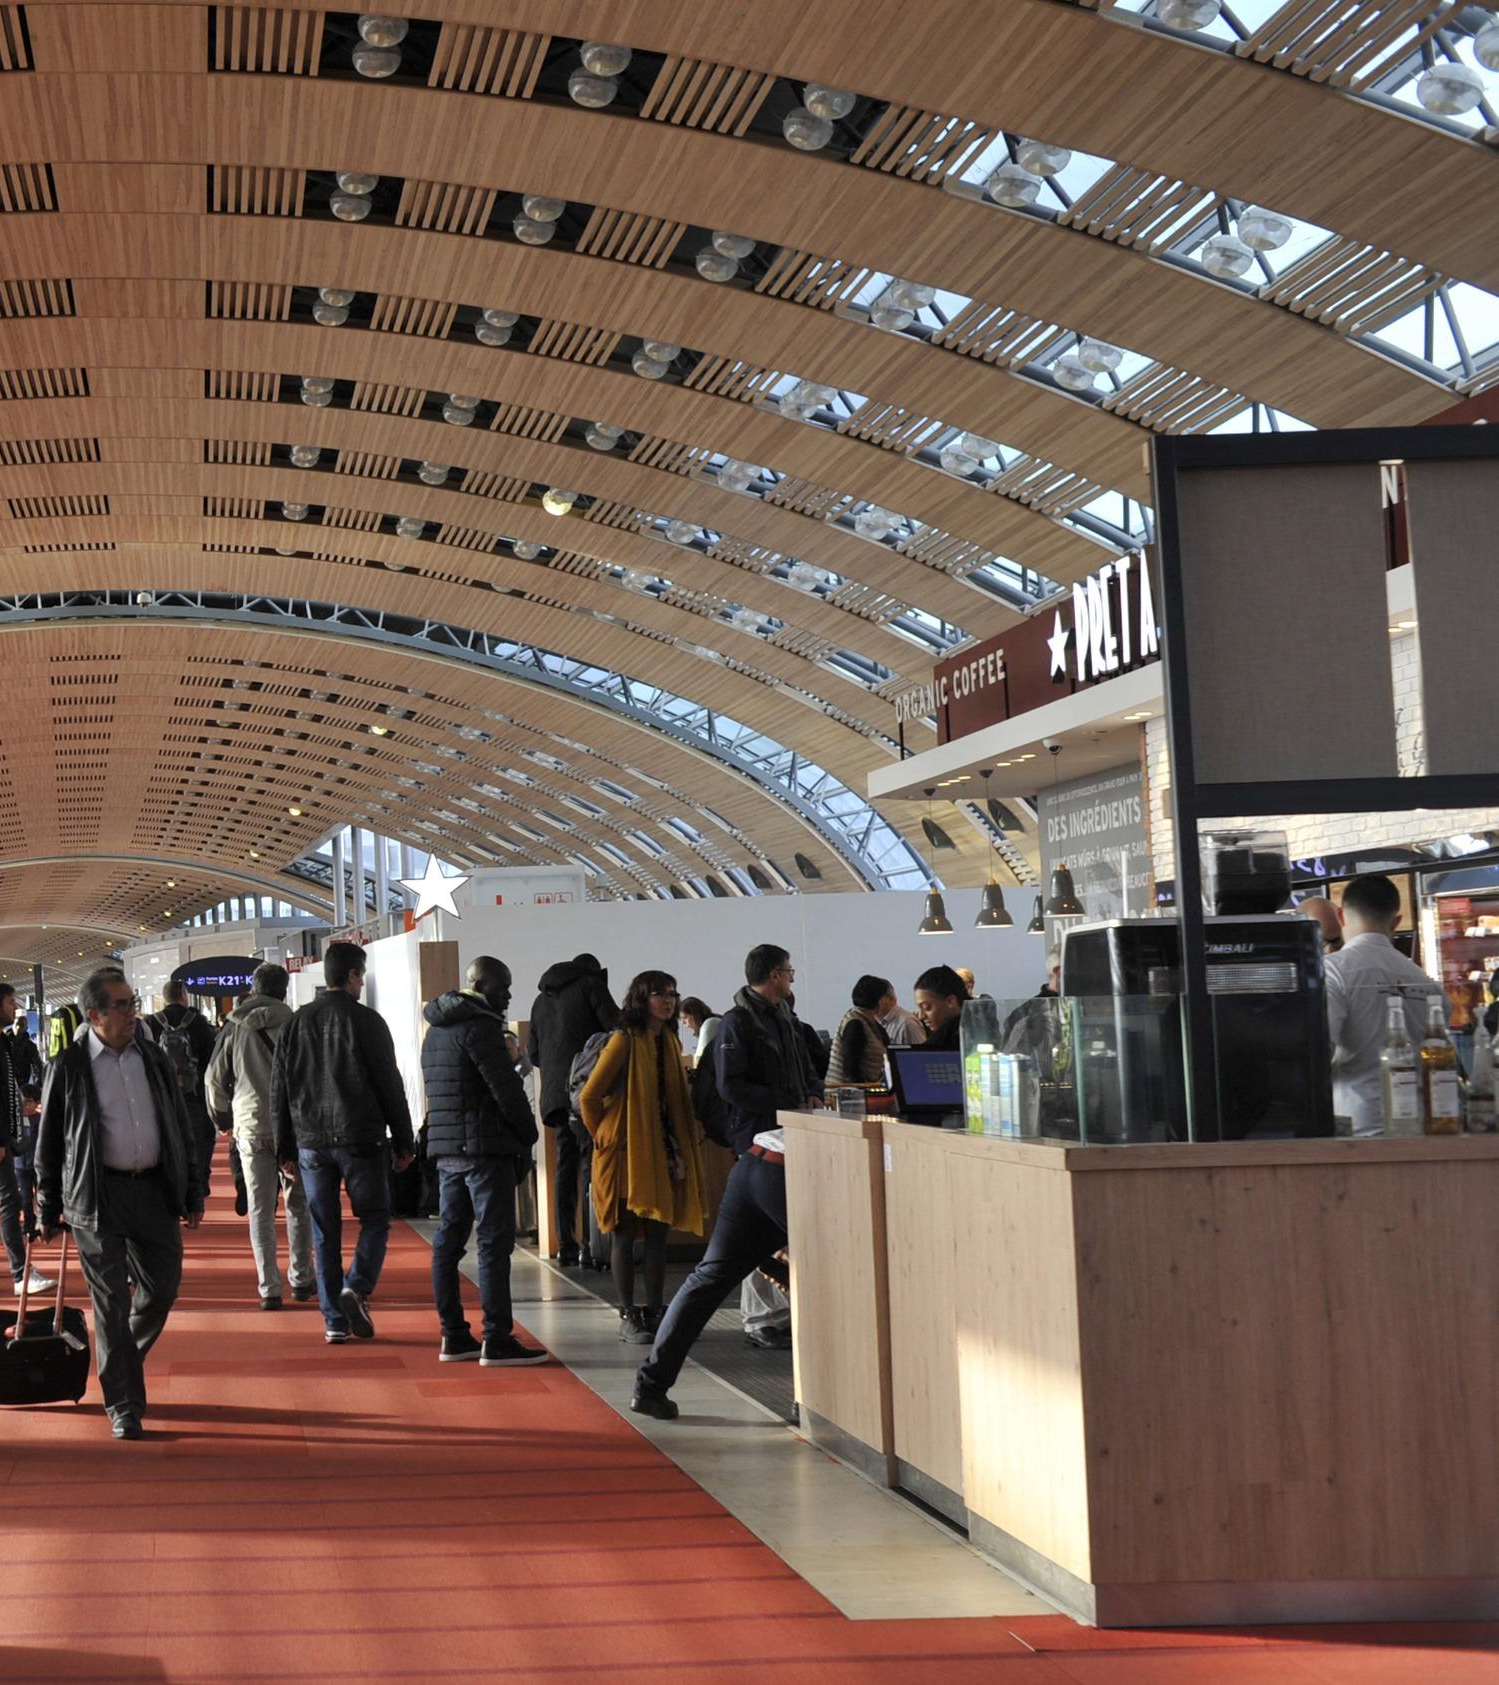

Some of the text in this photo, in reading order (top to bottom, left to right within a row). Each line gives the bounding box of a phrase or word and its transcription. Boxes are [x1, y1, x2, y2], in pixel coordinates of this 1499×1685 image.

[1073, 548, 1158, 682] PRET A
[894, 648, 1006, 723] ORGANIC COFFEE
[1047, 795, 1142, 843] DES INGRÉDIENTS
[219, 975, 239, 986] K21
[289, 956, 314, 971] RELAY
